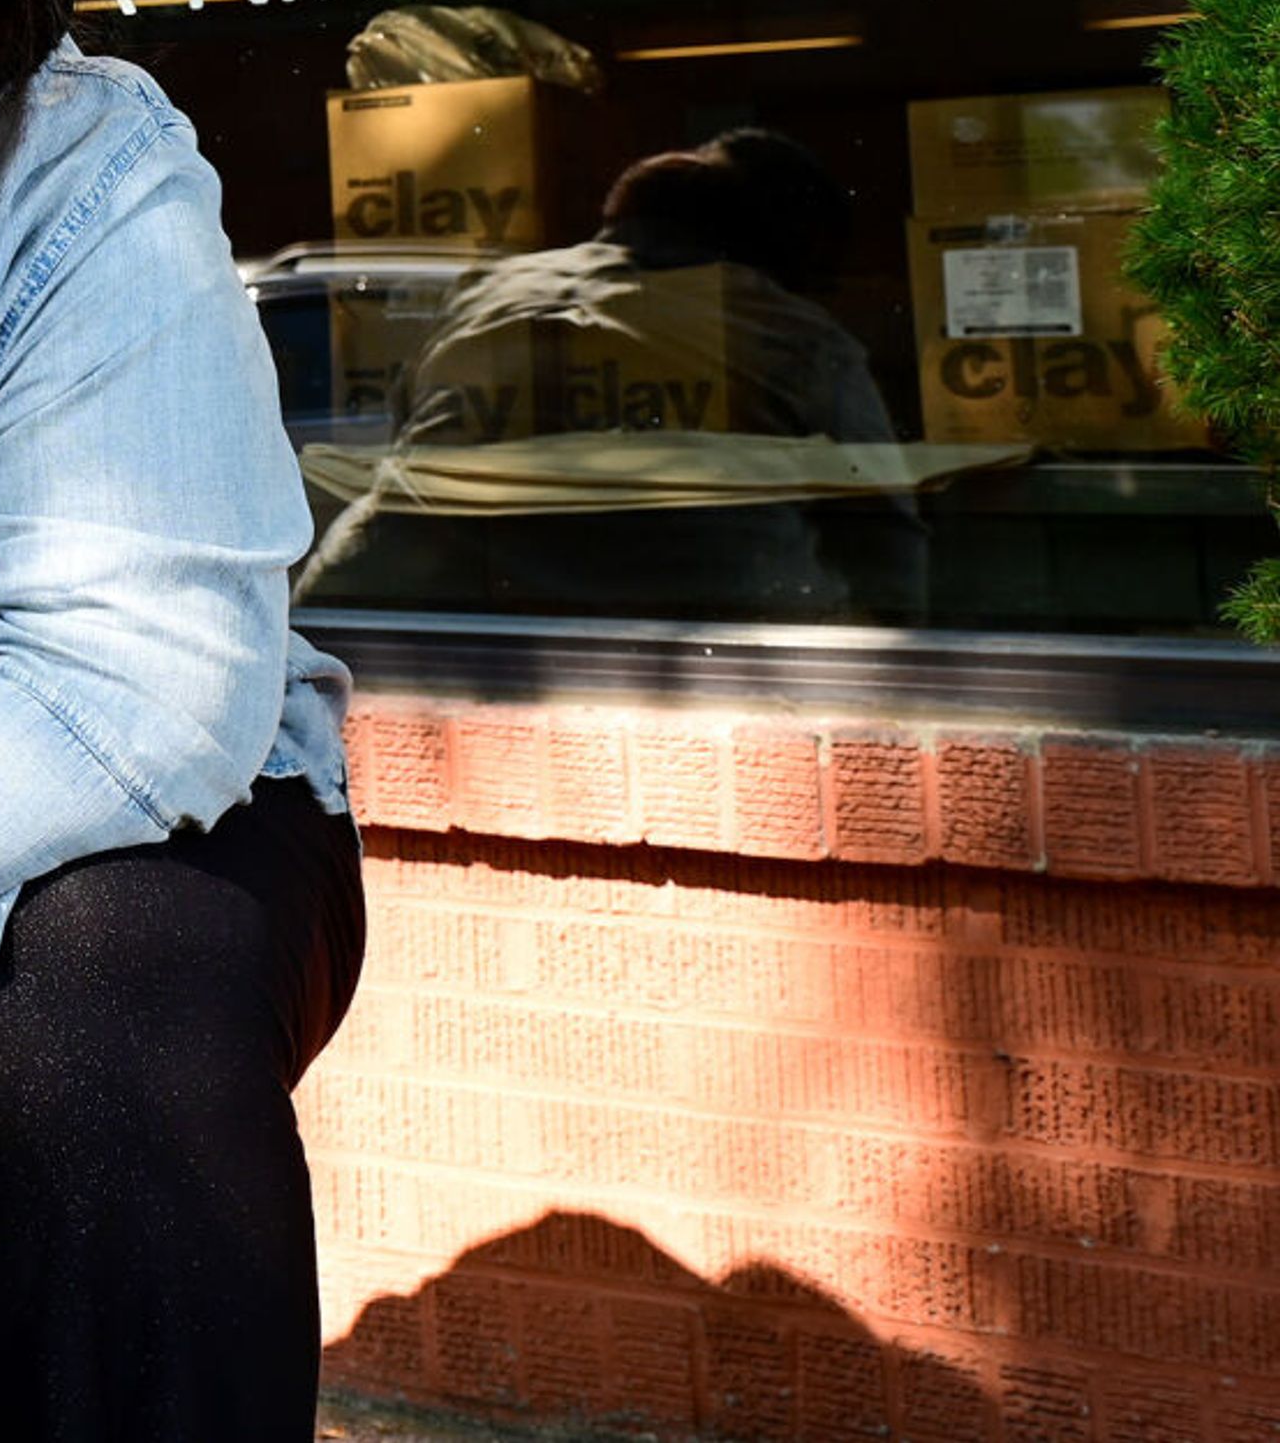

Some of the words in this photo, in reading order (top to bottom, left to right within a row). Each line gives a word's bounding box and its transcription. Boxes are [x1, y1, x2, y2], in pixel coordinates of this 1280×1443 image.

[347, 170, 520, 241] clay
[566, 357, 713, 433] clay
[940, 336, 1164, 417] clay
